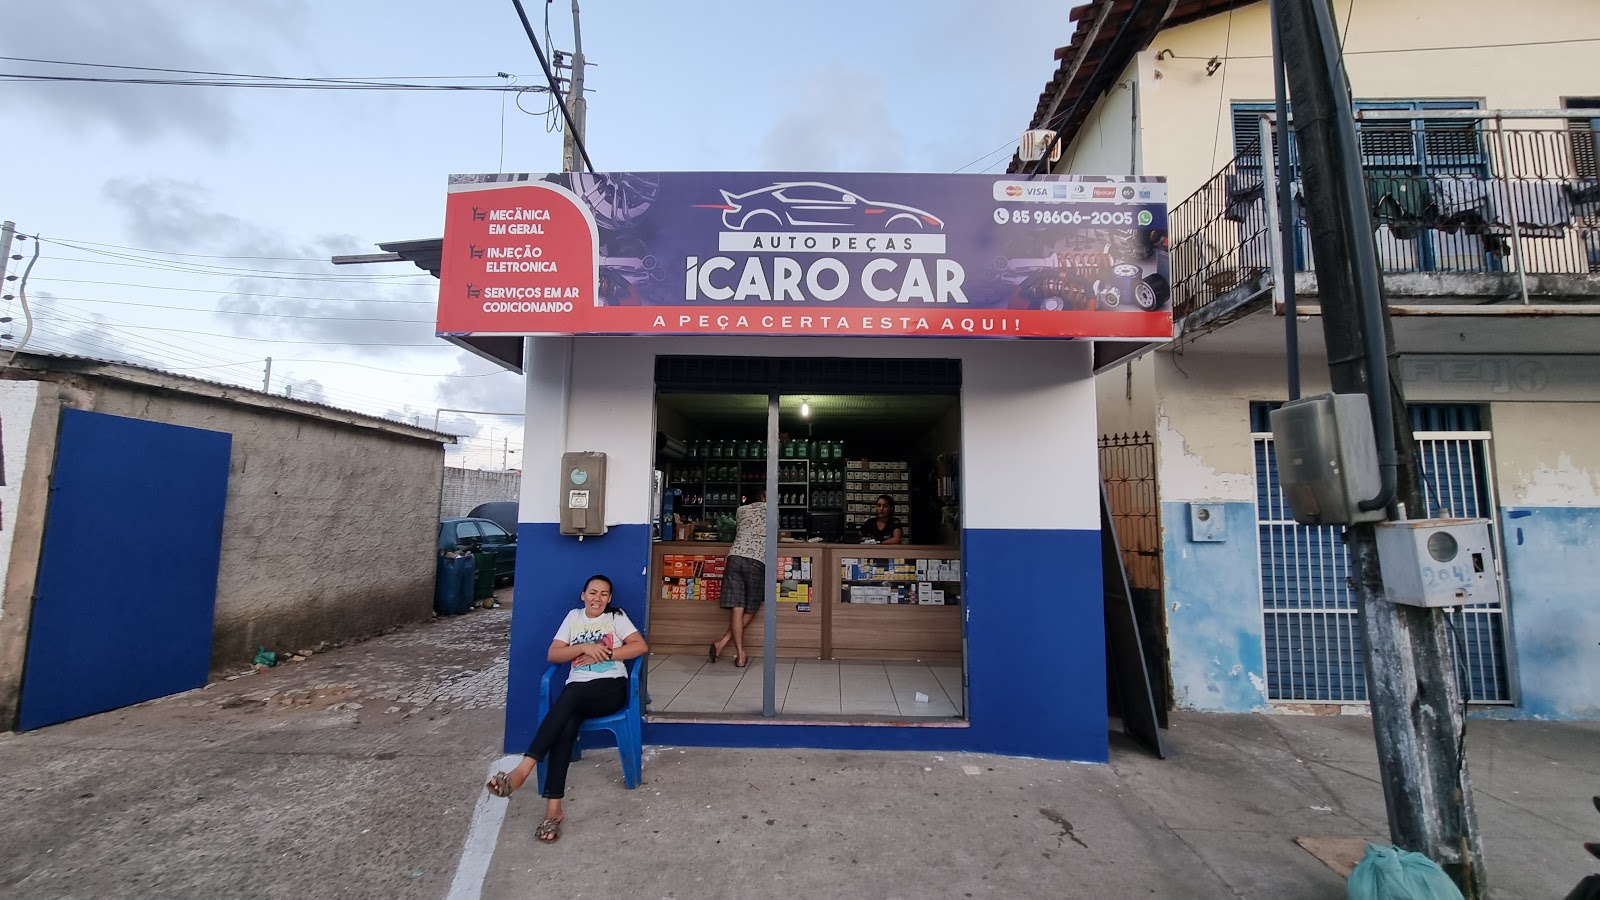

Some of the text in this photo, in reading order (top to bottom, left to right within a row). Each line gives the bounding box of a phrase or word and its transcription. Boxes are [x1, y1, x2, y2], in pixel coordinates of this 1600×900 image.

[1027, 187, 1048, 196] VISA
[1012, 210, 1133, 225] 85 98606-2005
[488, 224, 545, 235] EM GERAL
[752, 236, 913, 252] AUTO PEÇAS
[487, 244, 542, 260] INJEÇÃO
[486, 262, 558, 273] ELETRONICA
[861, 258, 969, 304] CAR
[484, 287, 580, 300] SERVIÇOS EM AR
[483, 301, 573, 313] CODICIONANDO
[653, 315, 1021, 332] A PEÇA CERTA ESTA AQUI!
